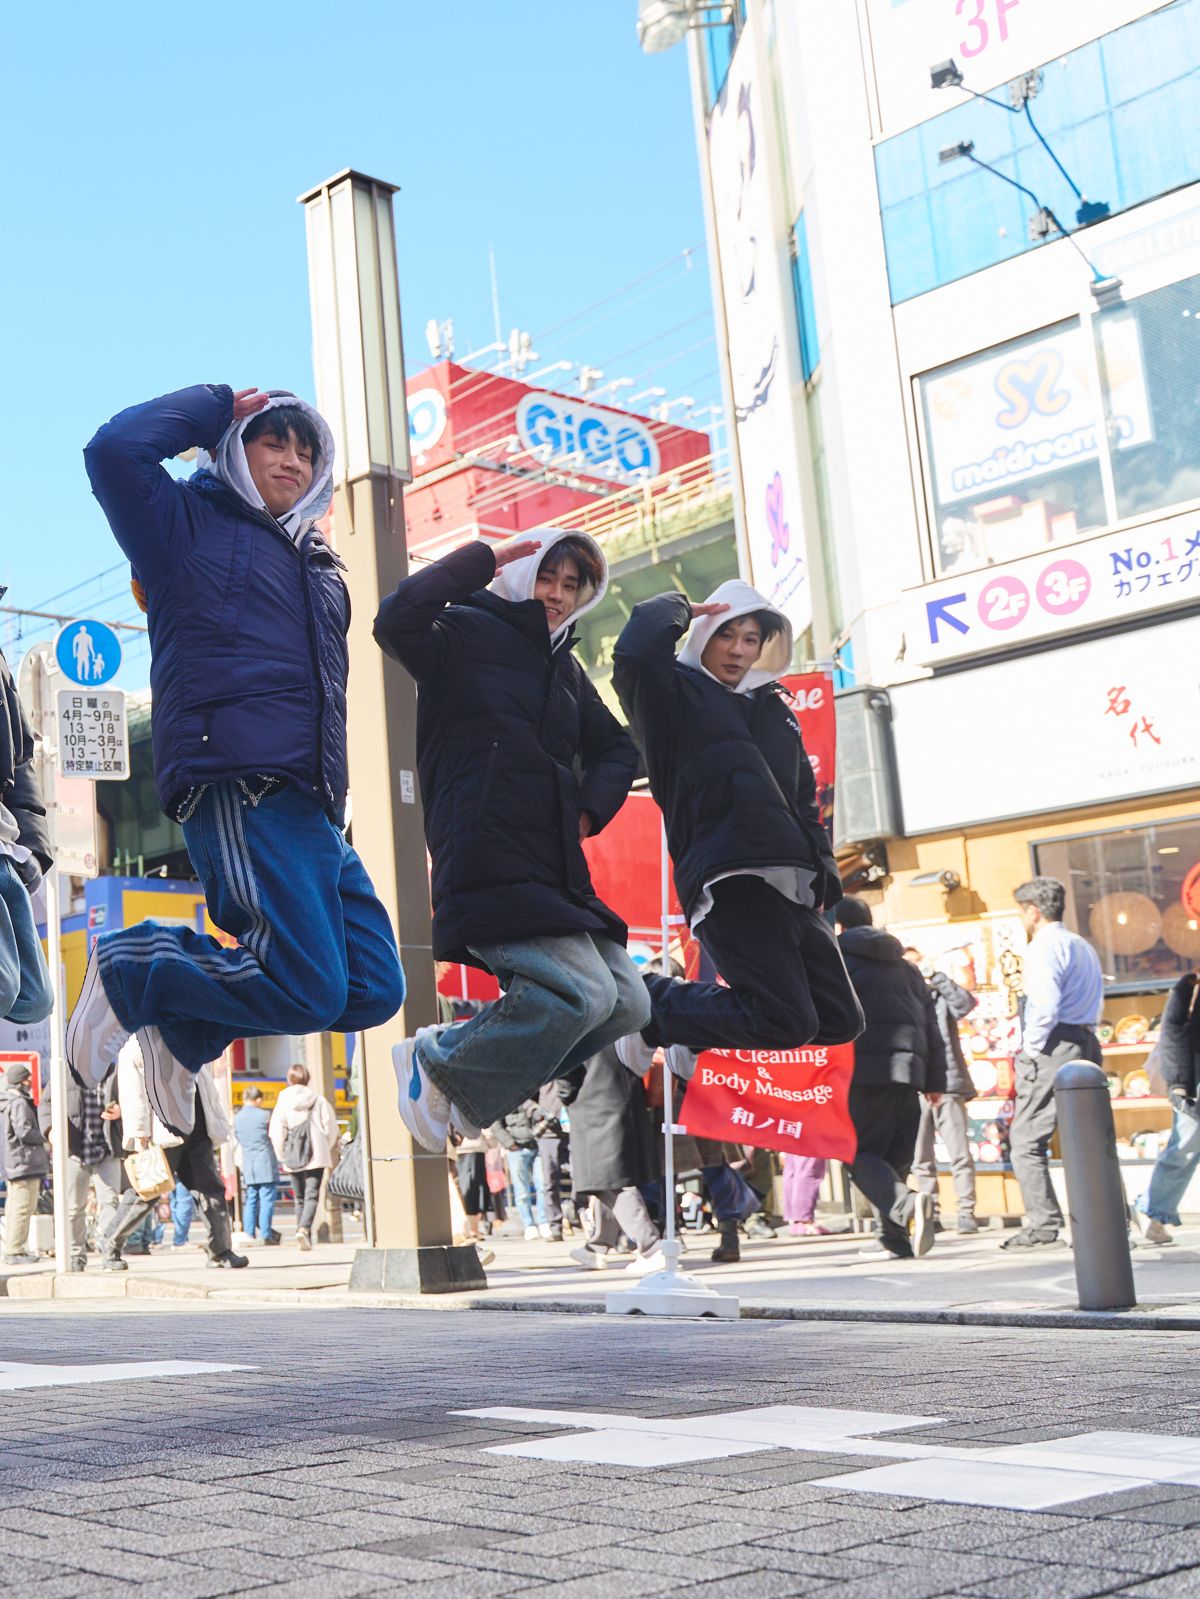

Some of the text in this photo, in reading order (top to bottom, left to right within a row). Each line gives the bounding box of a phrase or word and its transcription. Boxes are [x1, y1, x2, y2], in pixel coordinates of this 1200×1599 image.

[985, 570, 1087, 622] 2F 3F
[1114, 557, 1200, 599] カフェグ
[1104, 685, 1161, 747] 名代
[735, 1047, 829, 1067] Cleaning
[757, 1066, 773, 1081] &
[702, 1068, 833, 1105] Body Massage
[730, 1106, 803, 1140] 和ノ国
